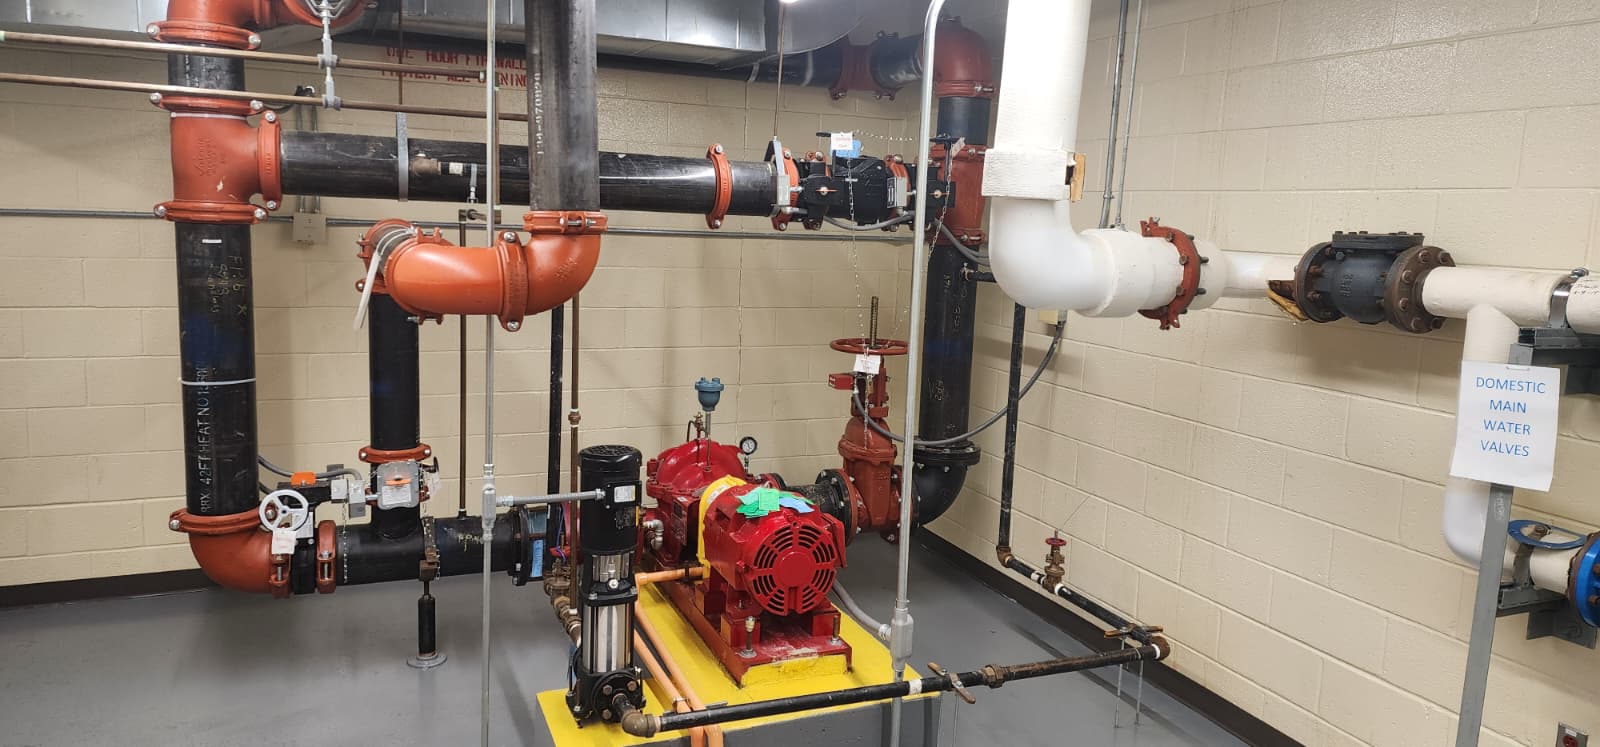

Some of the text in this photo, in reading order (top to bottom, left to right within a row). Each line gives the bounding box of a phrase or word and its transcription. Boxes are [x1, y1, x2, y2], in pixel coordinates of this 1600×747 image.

[1476, 376, 1546, 394] DOMESTIC
[197, 398, 210, 416] NO
[1490, 399, 1527, 414] MAIN
[197, 419, 211, 452] HEAT
[1483, 419, 1531, 436] WATER
[1480, 440, 1530, 457] VALVES
